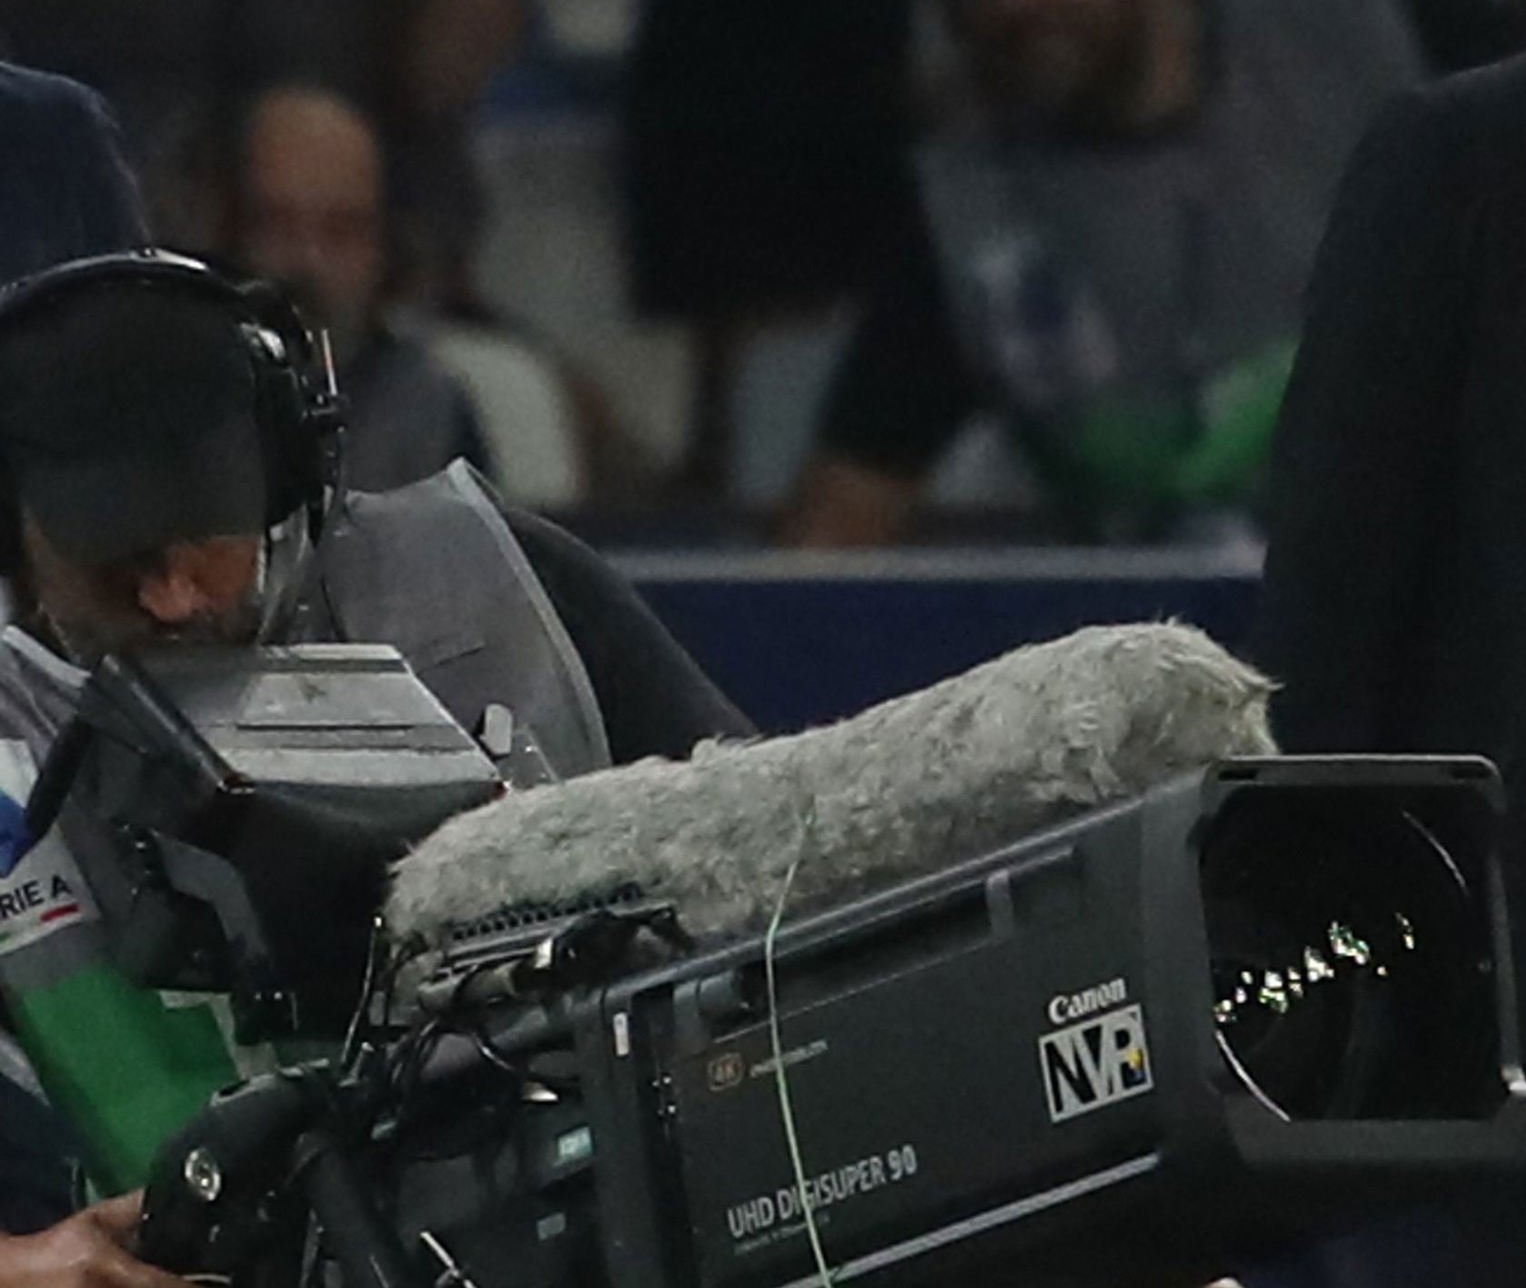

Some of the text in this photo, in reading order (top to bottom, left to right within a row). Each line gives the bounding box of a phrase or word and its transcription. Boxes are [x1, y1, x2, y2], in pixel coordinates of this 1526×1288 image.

[50, 874, 73, 899] A
[1048, 977, 1128, 1025] Canon
[727, 1196, 775, 1238] UHD
[777, 1155, 887, 1221] DIGISUPER
[887, 1144, 918, 1181] 90
